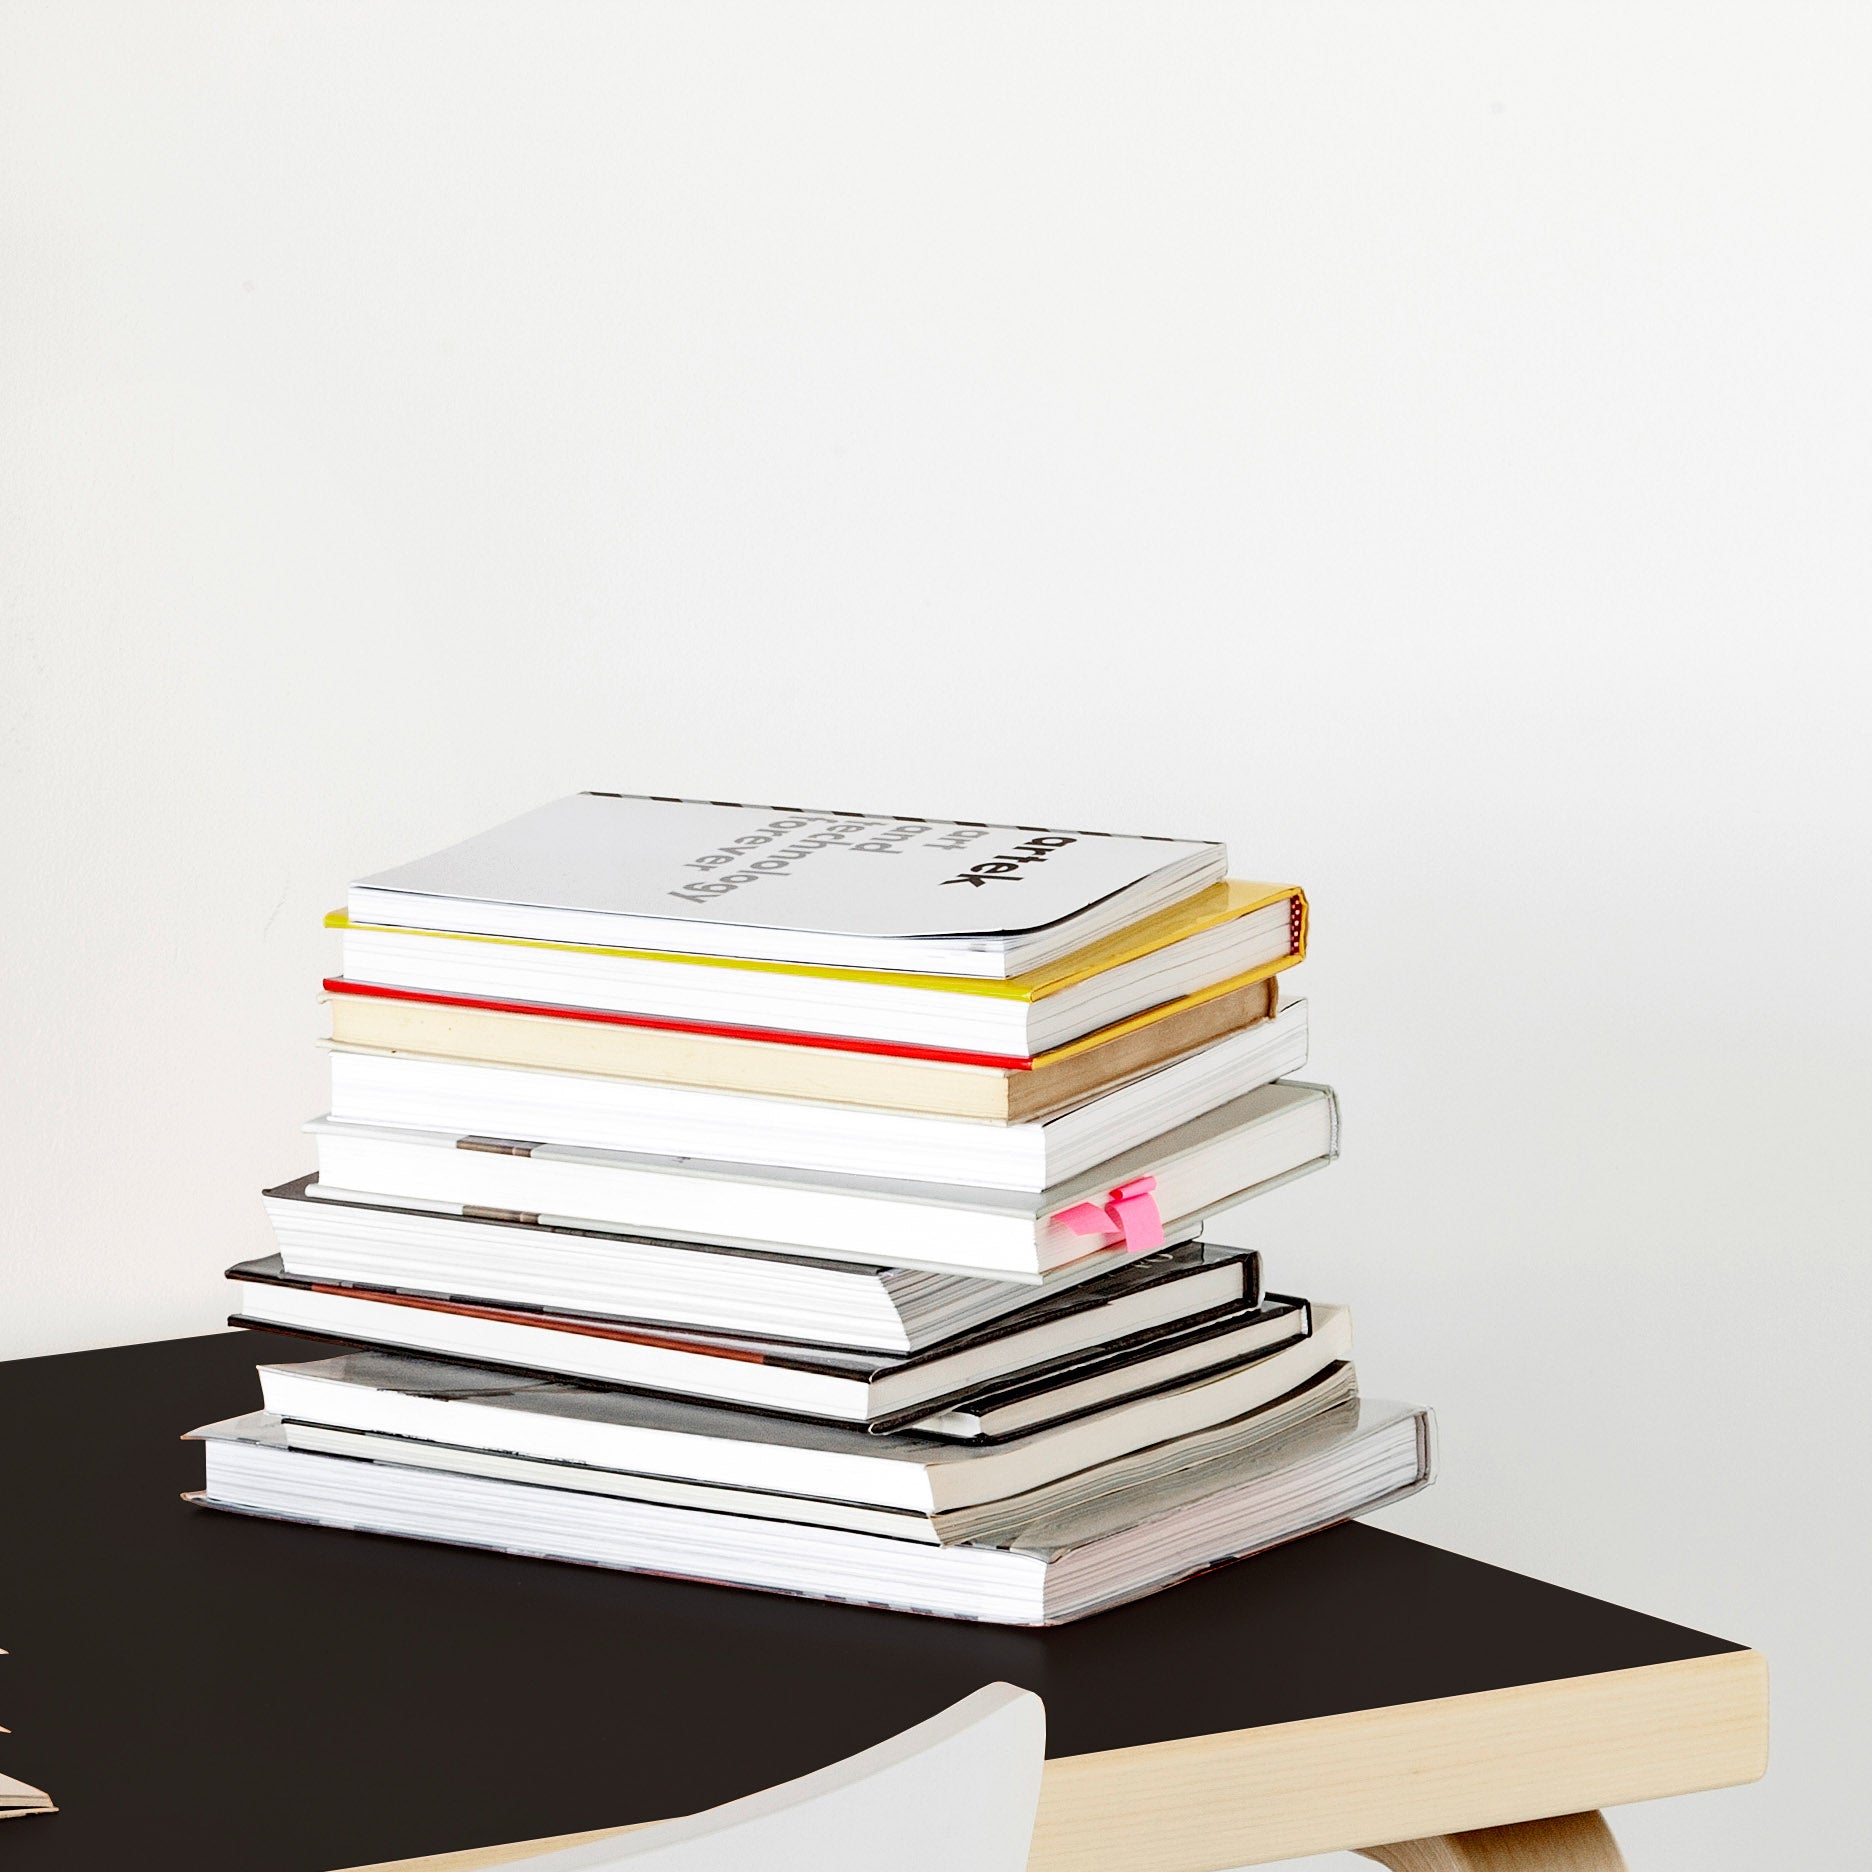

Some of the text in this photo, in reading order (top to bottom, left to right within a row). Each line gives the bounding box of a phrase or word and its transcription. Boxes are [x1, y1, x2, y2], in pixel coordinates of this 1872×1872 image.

[667, 821, 888, 903] technology
[683, 816, 838, 871] forever
[848, 825, 932, 854] and
[923, 830, 990, 850] art
[938, 837, 1077, 887] artek
